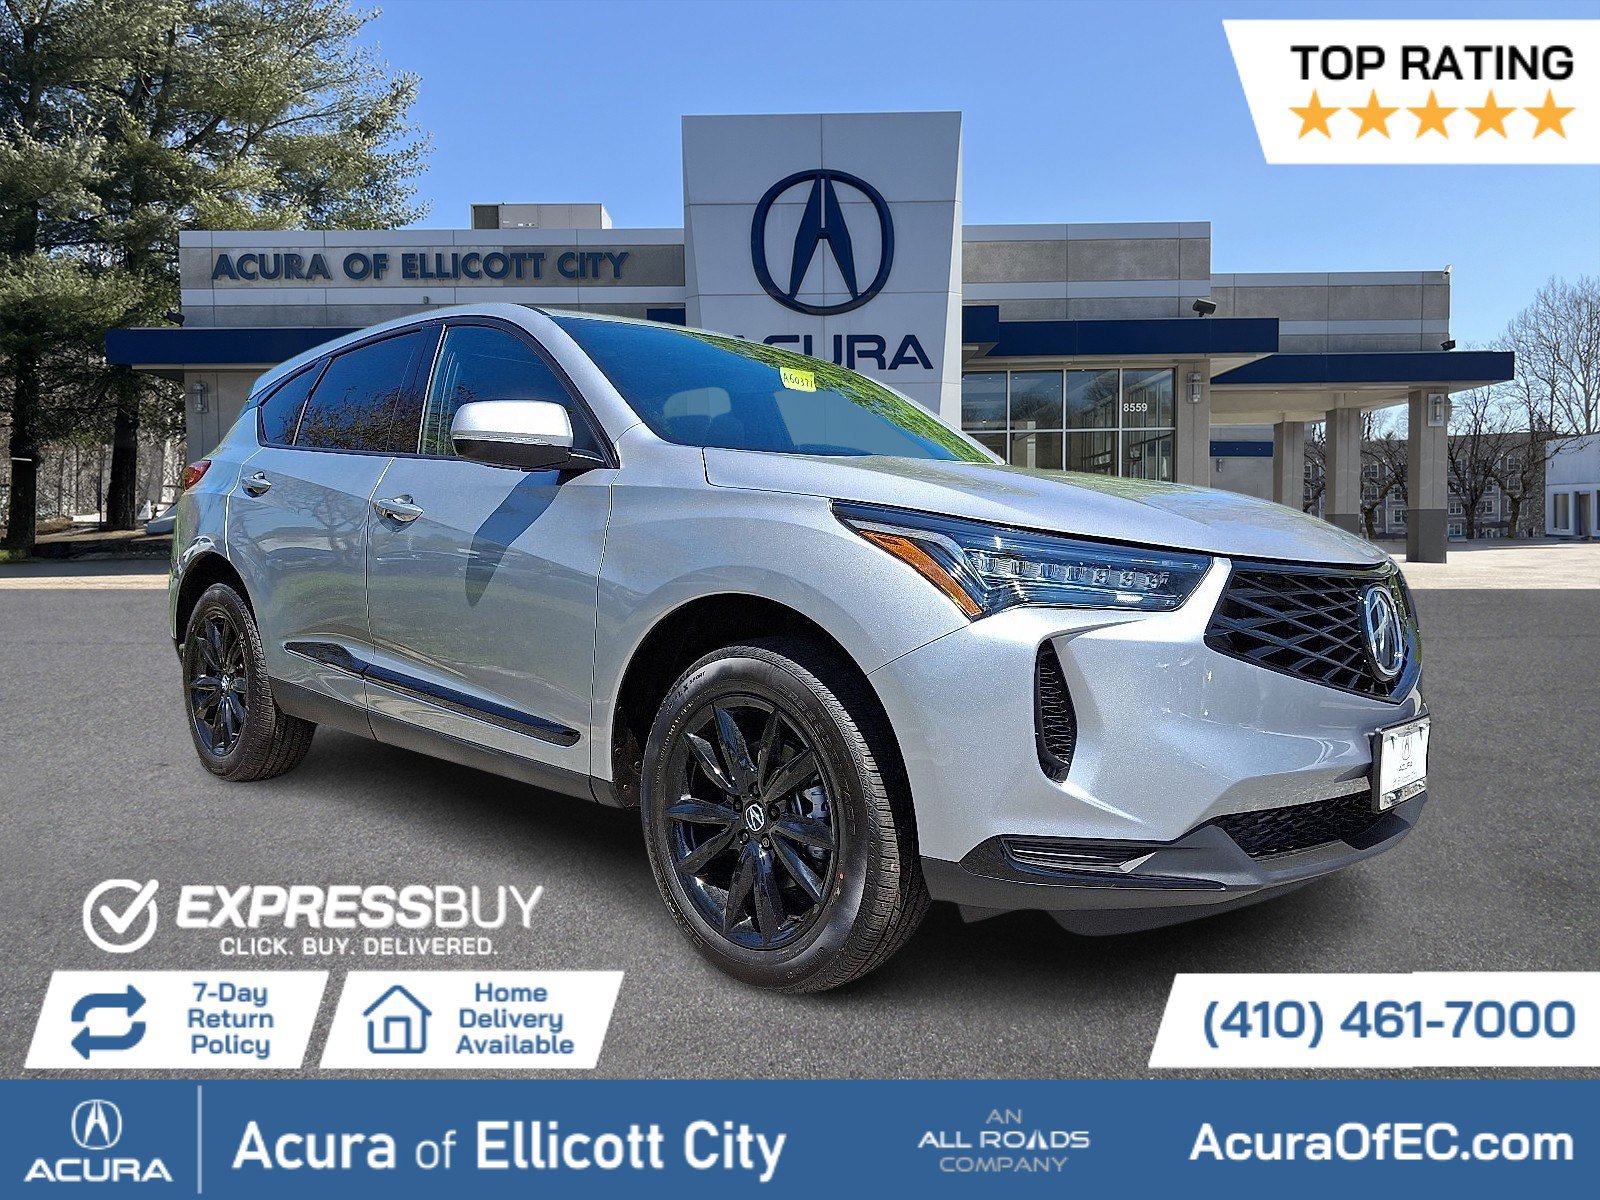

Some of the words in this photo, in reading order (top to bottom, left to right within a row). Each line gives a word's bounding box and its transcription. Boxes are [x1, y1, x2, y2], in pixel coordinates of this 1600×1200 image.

[211, 253, 332, 281] ACURA
[342, 252, 390, 280] OF
[401, 252, 546, 280] ELLICOTT
[556, 251, 630, 280] CITY
[1123, 402, 1148, 412] 8559
